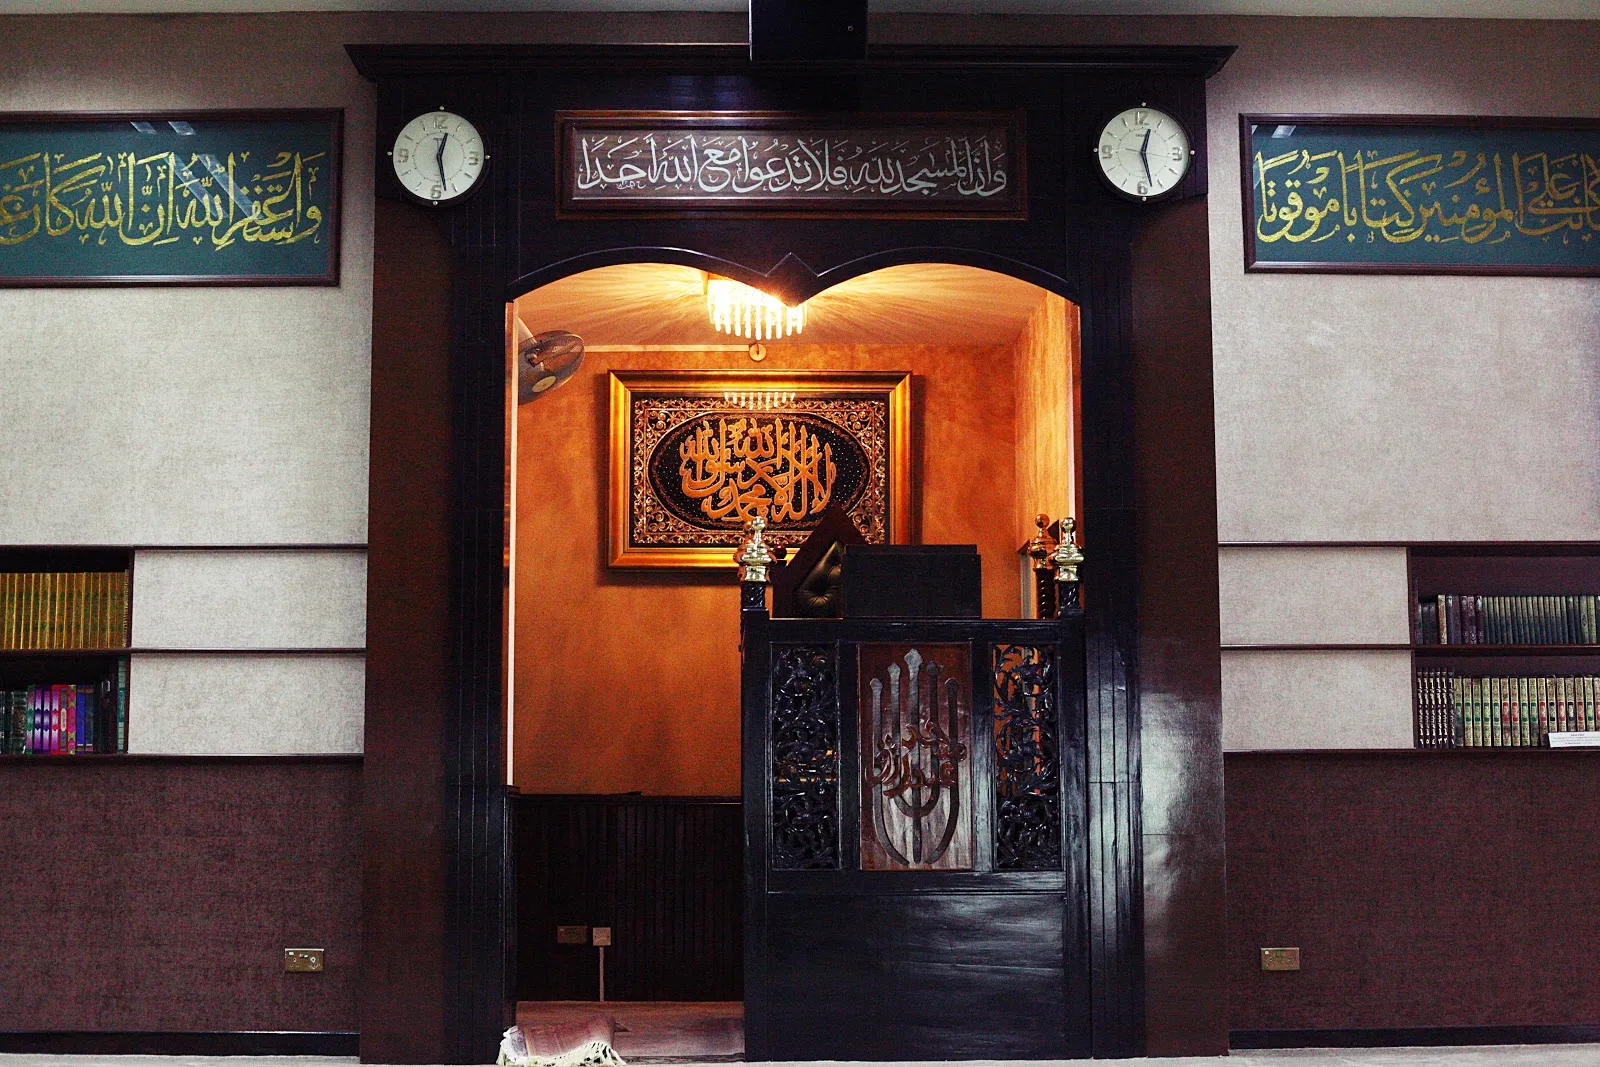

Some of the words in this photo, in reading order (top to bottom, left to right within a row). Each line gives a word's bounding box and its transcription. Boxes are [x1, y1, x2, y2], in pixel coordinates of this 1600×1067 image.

[1102, 145, 1113, 159] 9
[1173, 146, 1183, 161] 3
[430, 185, 441, 199] 6
[1137, 180, 1148, 195] 6
